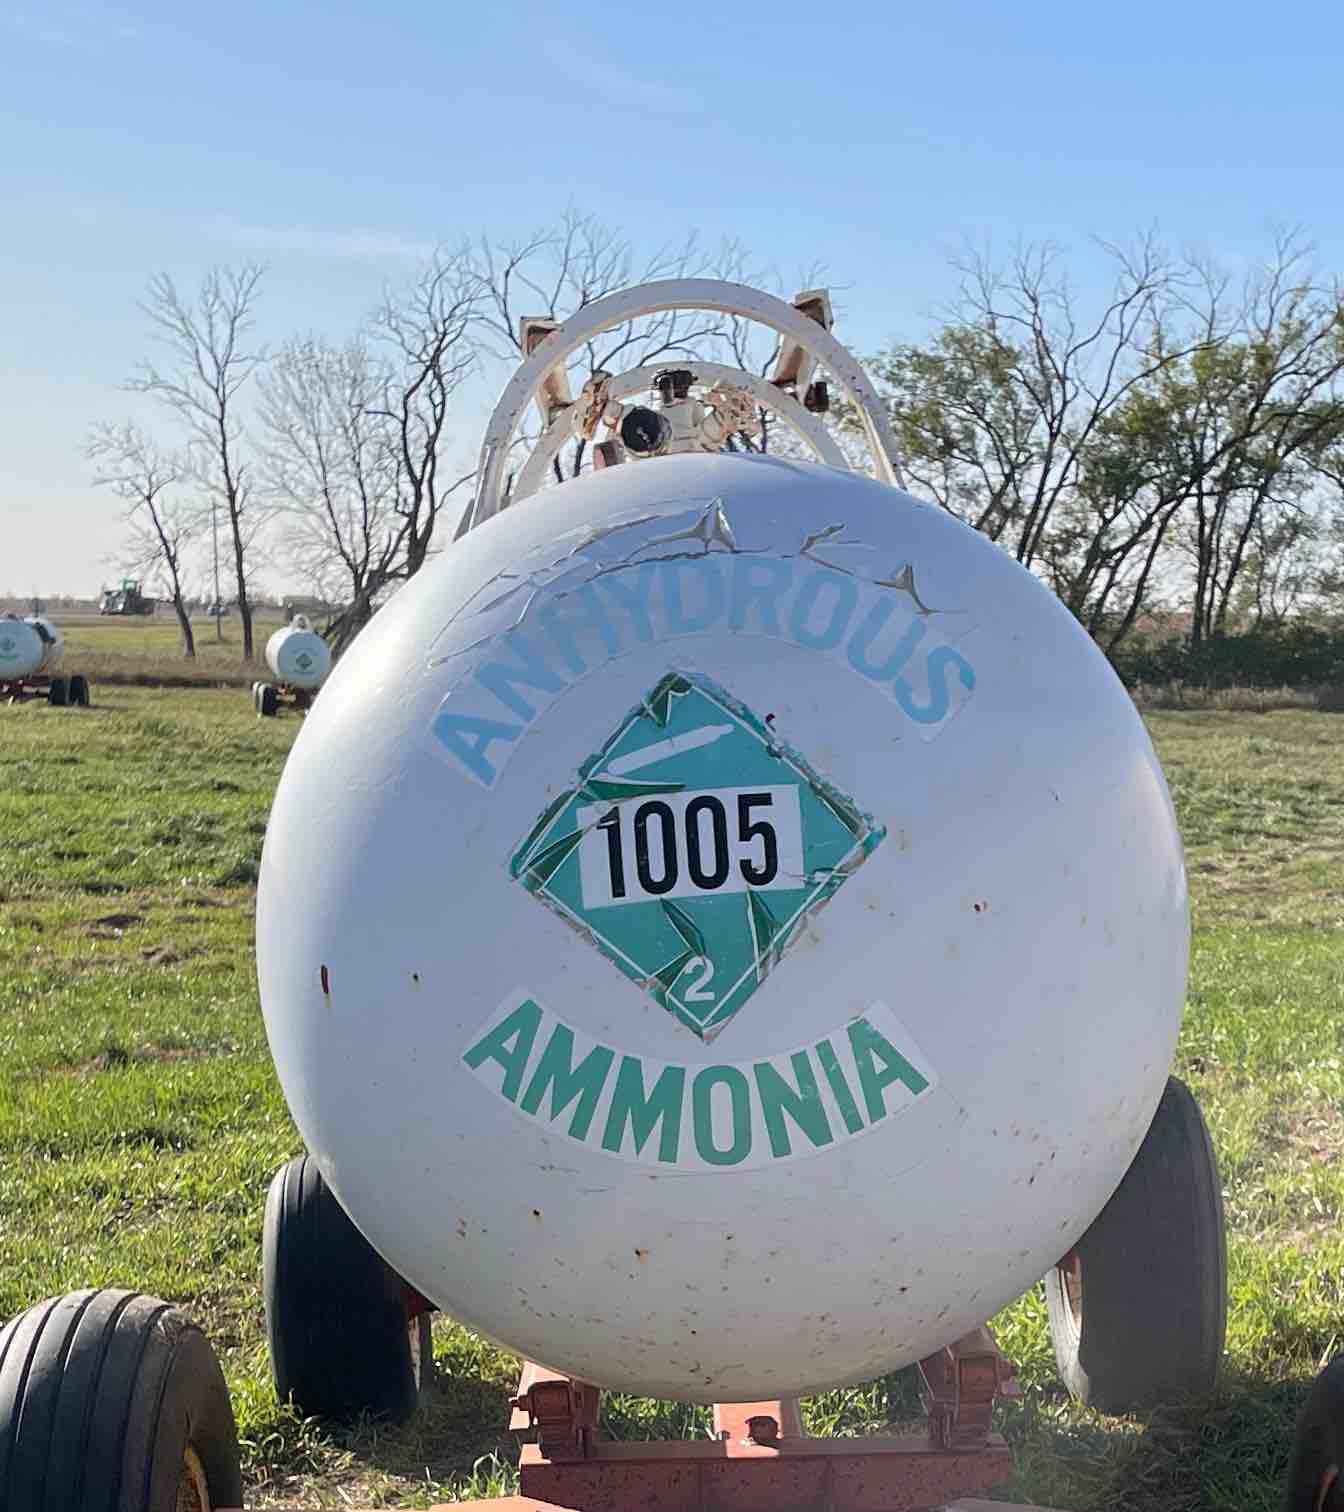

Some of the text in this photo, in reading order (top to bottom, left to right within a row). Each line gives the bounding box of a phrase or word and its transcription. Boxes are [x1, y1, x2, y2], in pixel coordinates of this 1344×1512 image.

[432, 554, 978, 787] ANHYDROUS
[596, 792, 778, 898] 1005
[683, 957, 716, 1002] 2
[462, 999, 930, 1167] AMMONIA
